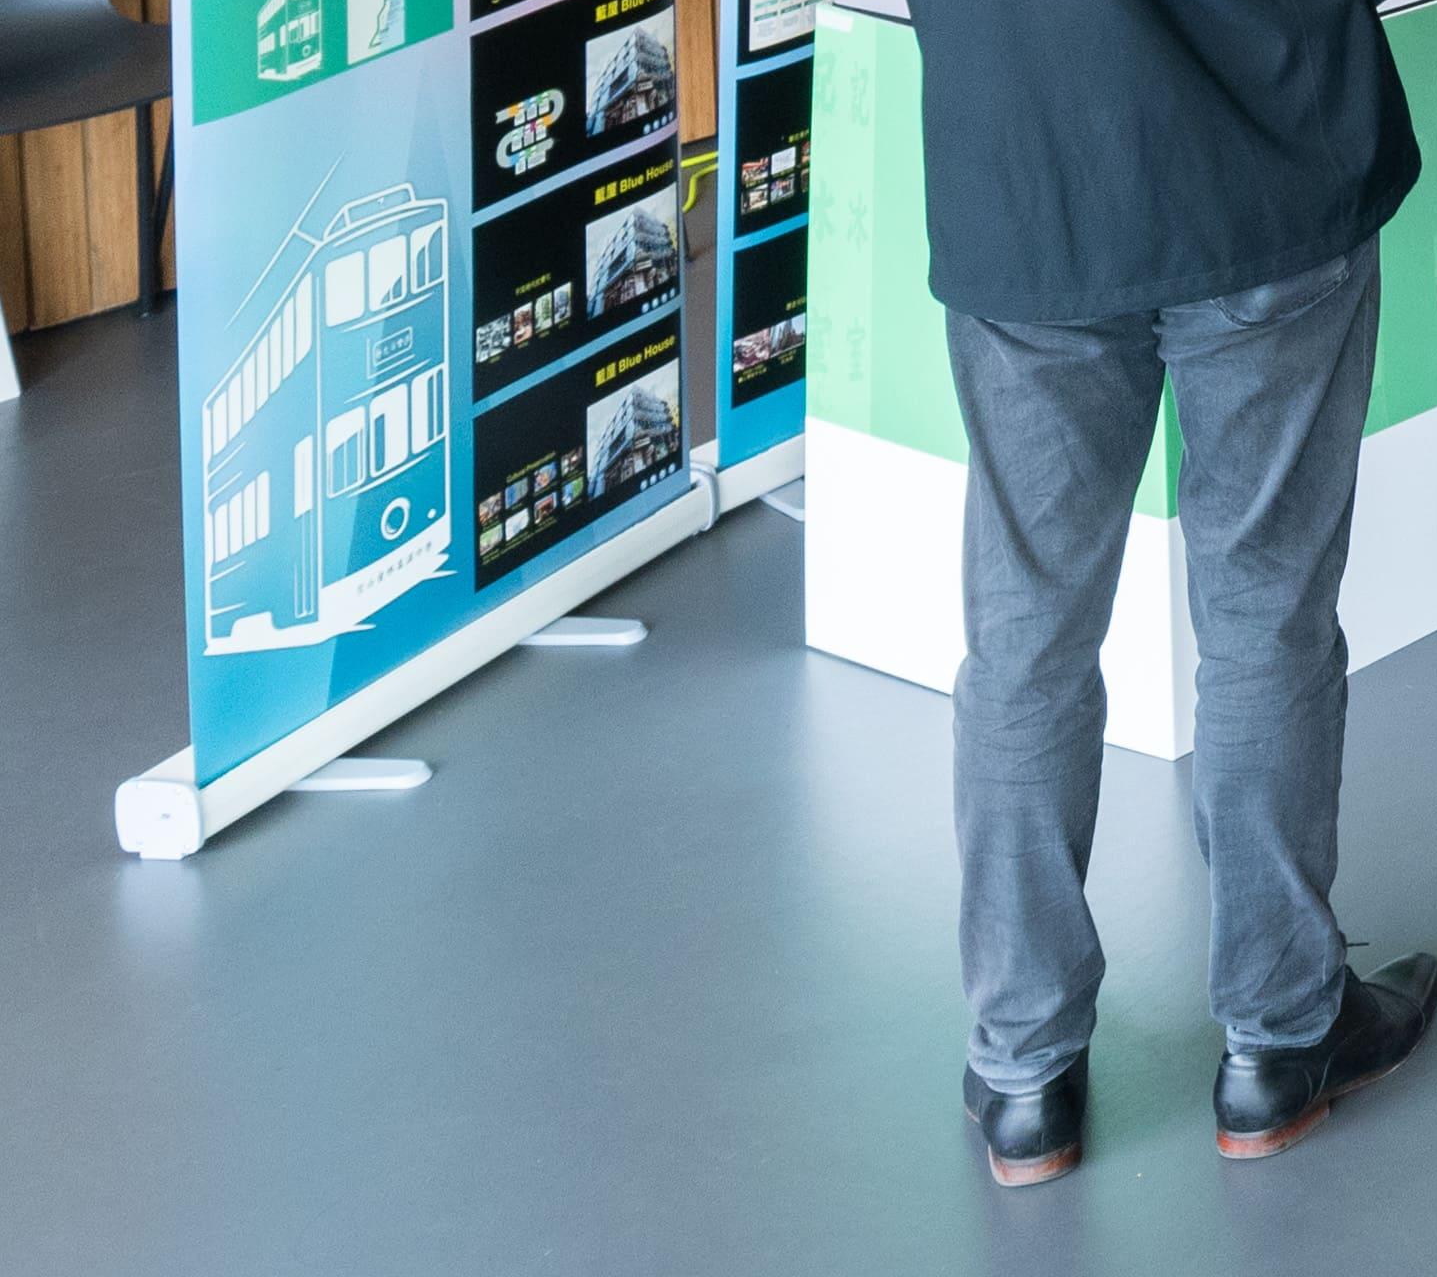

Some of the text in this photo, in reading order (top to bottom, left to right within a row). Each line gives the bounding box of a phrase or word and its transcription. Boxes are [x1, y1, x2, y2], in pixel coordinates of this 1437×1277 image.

[620, 172, 644, 191] Blue
[646, 158, 674, 180] House
[618, 354, 642, 373] Blue
[644, 335, 675, 359] House
